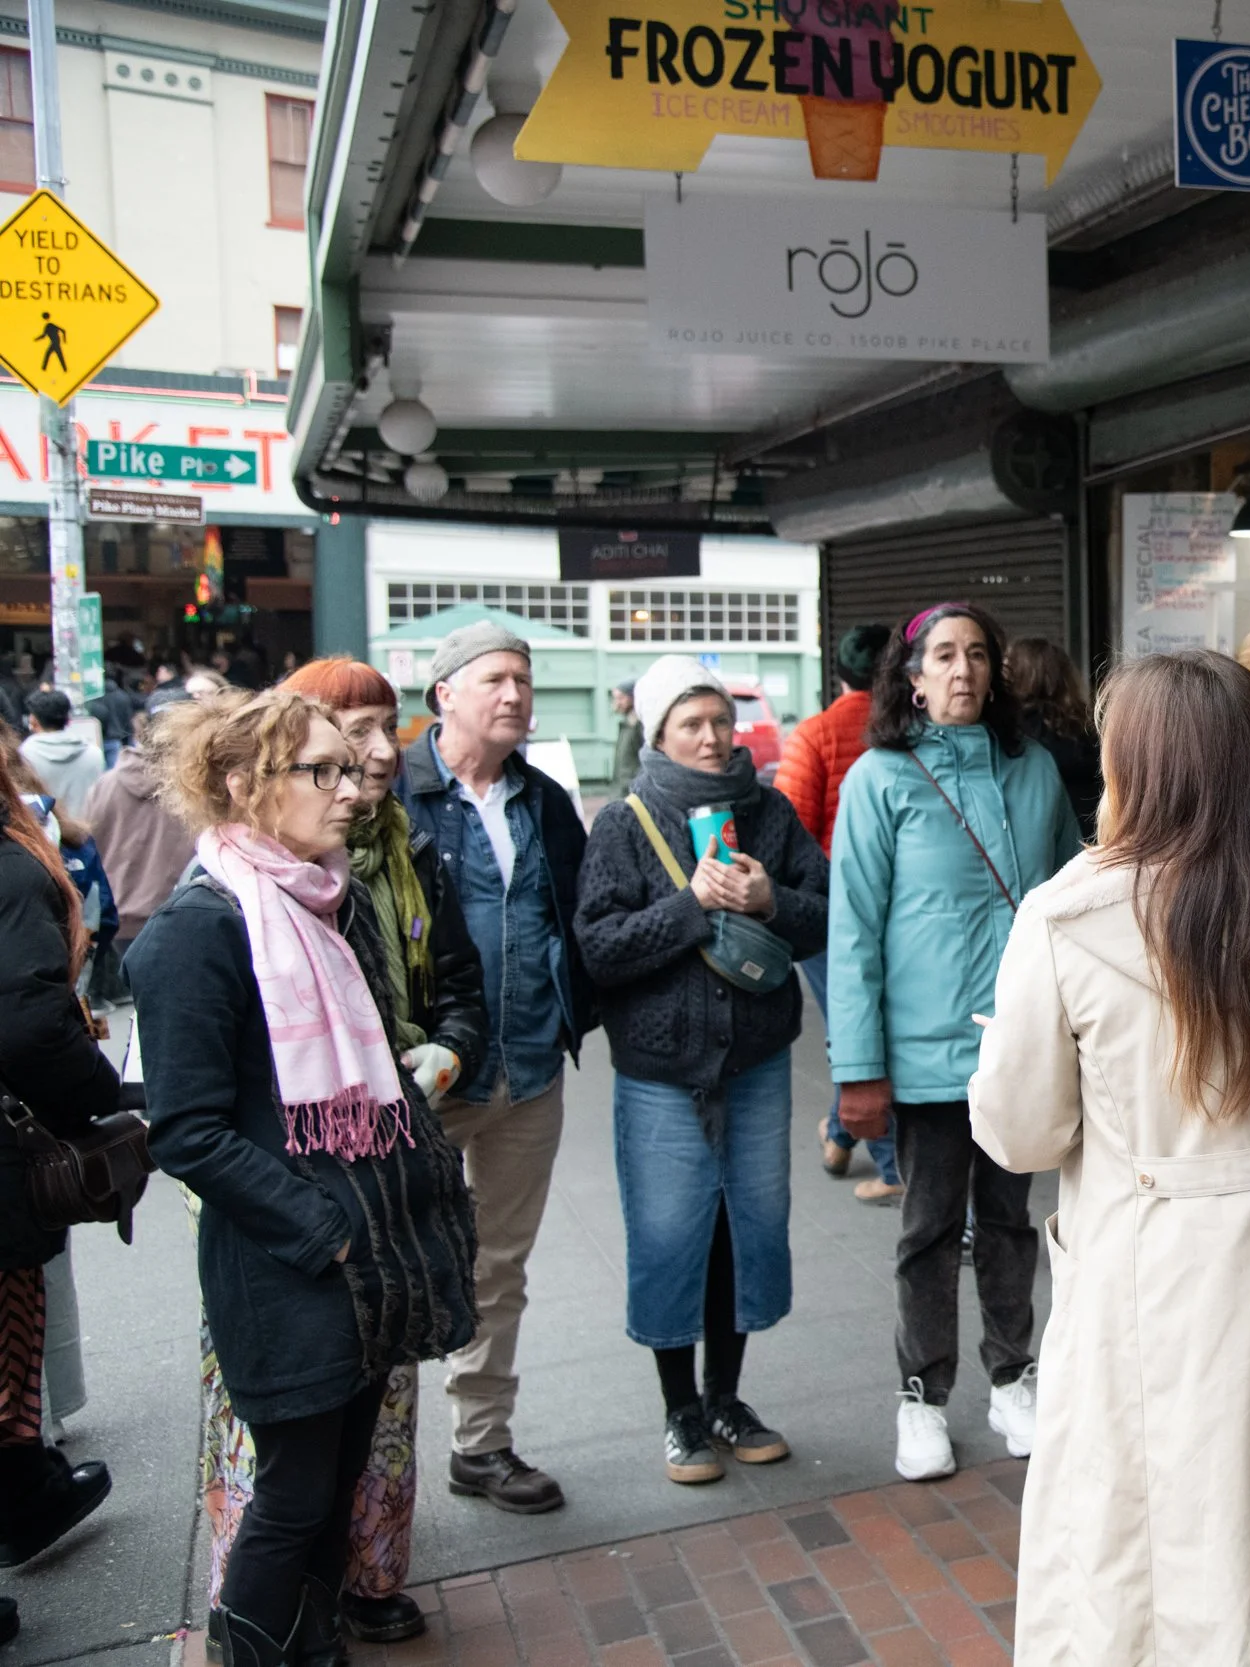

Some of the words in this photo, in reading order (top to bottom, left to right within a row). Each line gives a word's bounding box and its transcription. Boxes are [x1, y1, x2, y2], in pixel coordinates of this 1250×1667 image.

[818, 0, 933, 34] GIANT
[606, 17, 854, 98] FROZEN
[870, 39, 1077, 115] YOGURT
[651, 92, 698, 119] ICE
[702, 97, 791, 127] CREAM
[897, 109, 1022, 143] SMOOTHIES
[15, 229, 79, 251] YIELD
[35, 255, 61, 276] TO
[668, 328, 724, 344] ROJO
[735, 330, 794, 347] JUICE
[918, 338, 962, 351] PIKE
[971, 340, 1034, 353] PLACE
[98, 443, 165, 475] Pike
